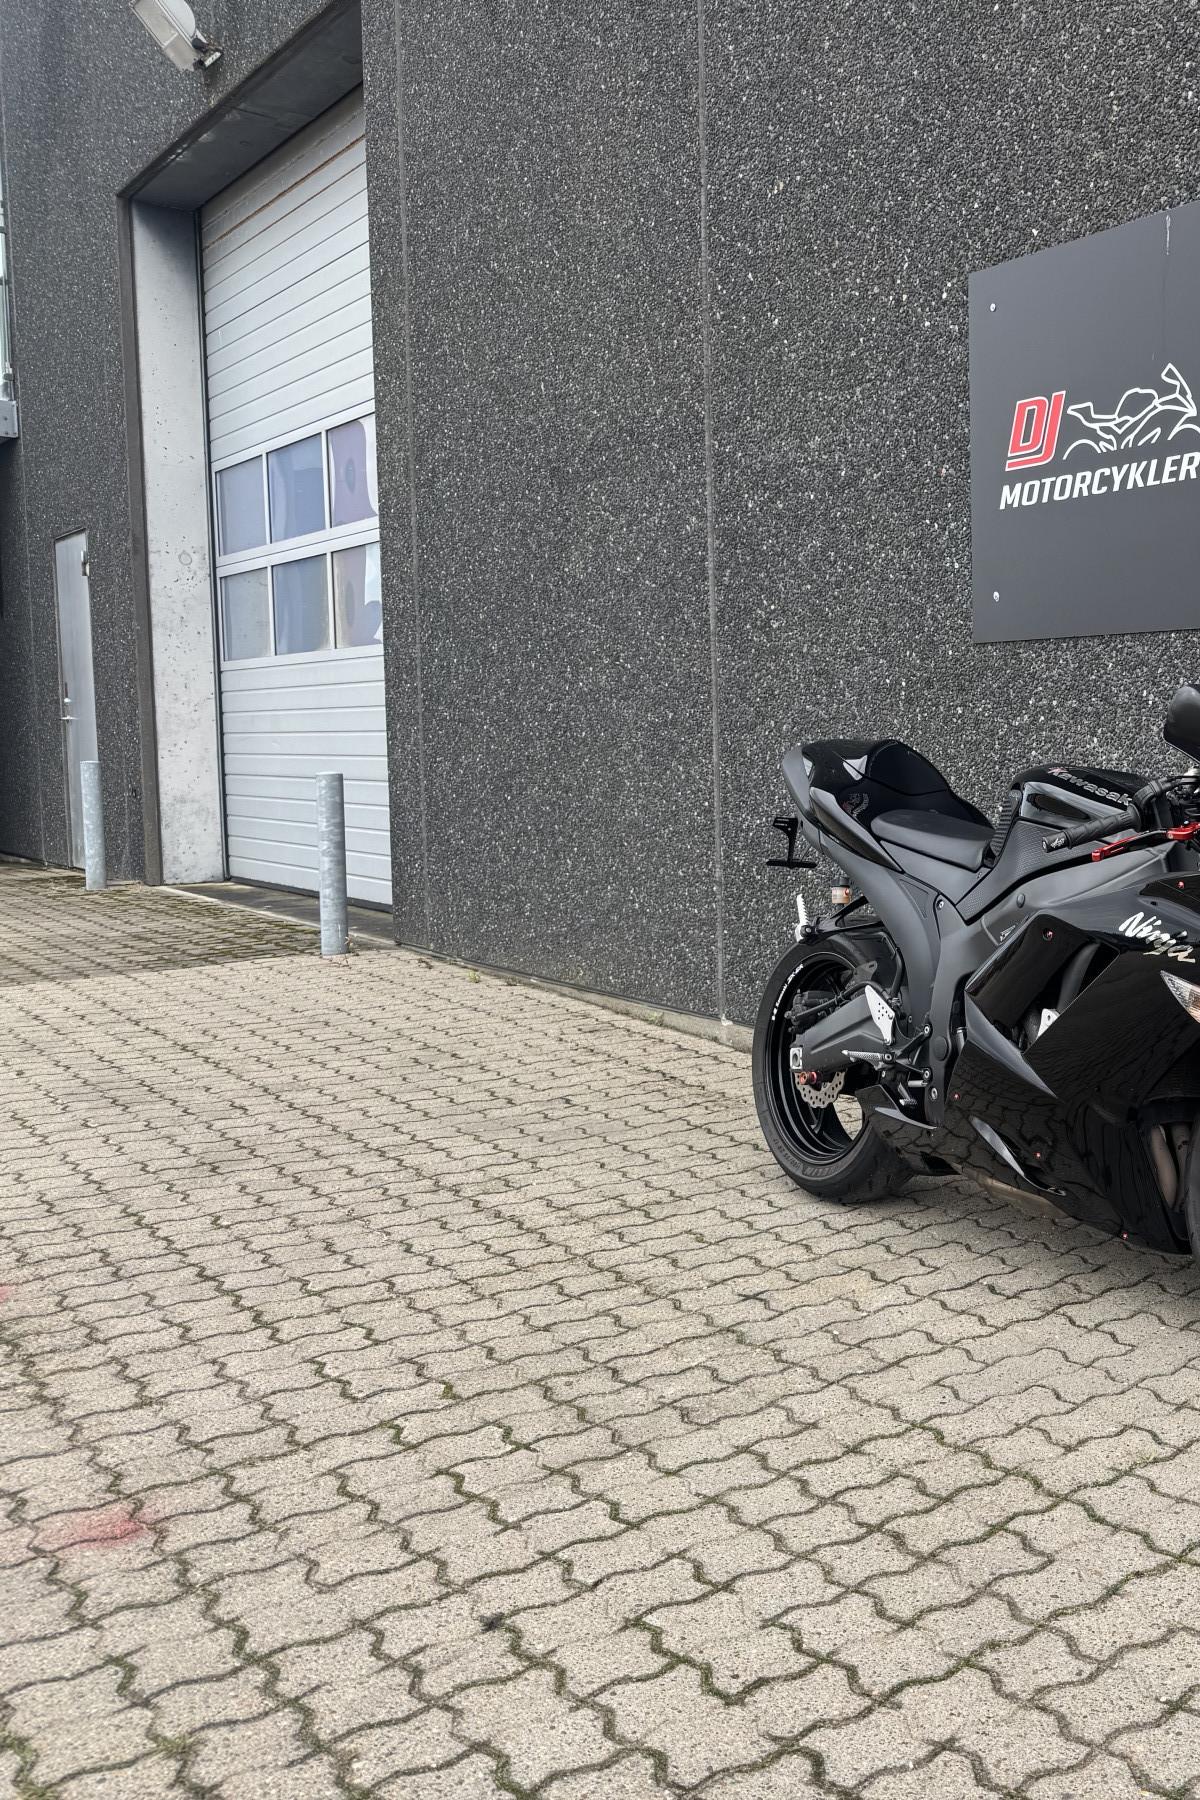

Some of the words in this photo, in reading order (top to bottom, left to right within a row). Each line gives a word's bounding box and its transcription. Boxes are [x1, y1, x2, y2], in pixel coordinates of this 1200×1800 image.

[1005, 390, 1066, 472] DJ
[1047, 766, 1133, 806] Kawasak
[1118, 911, 1196, 963] Ninja
